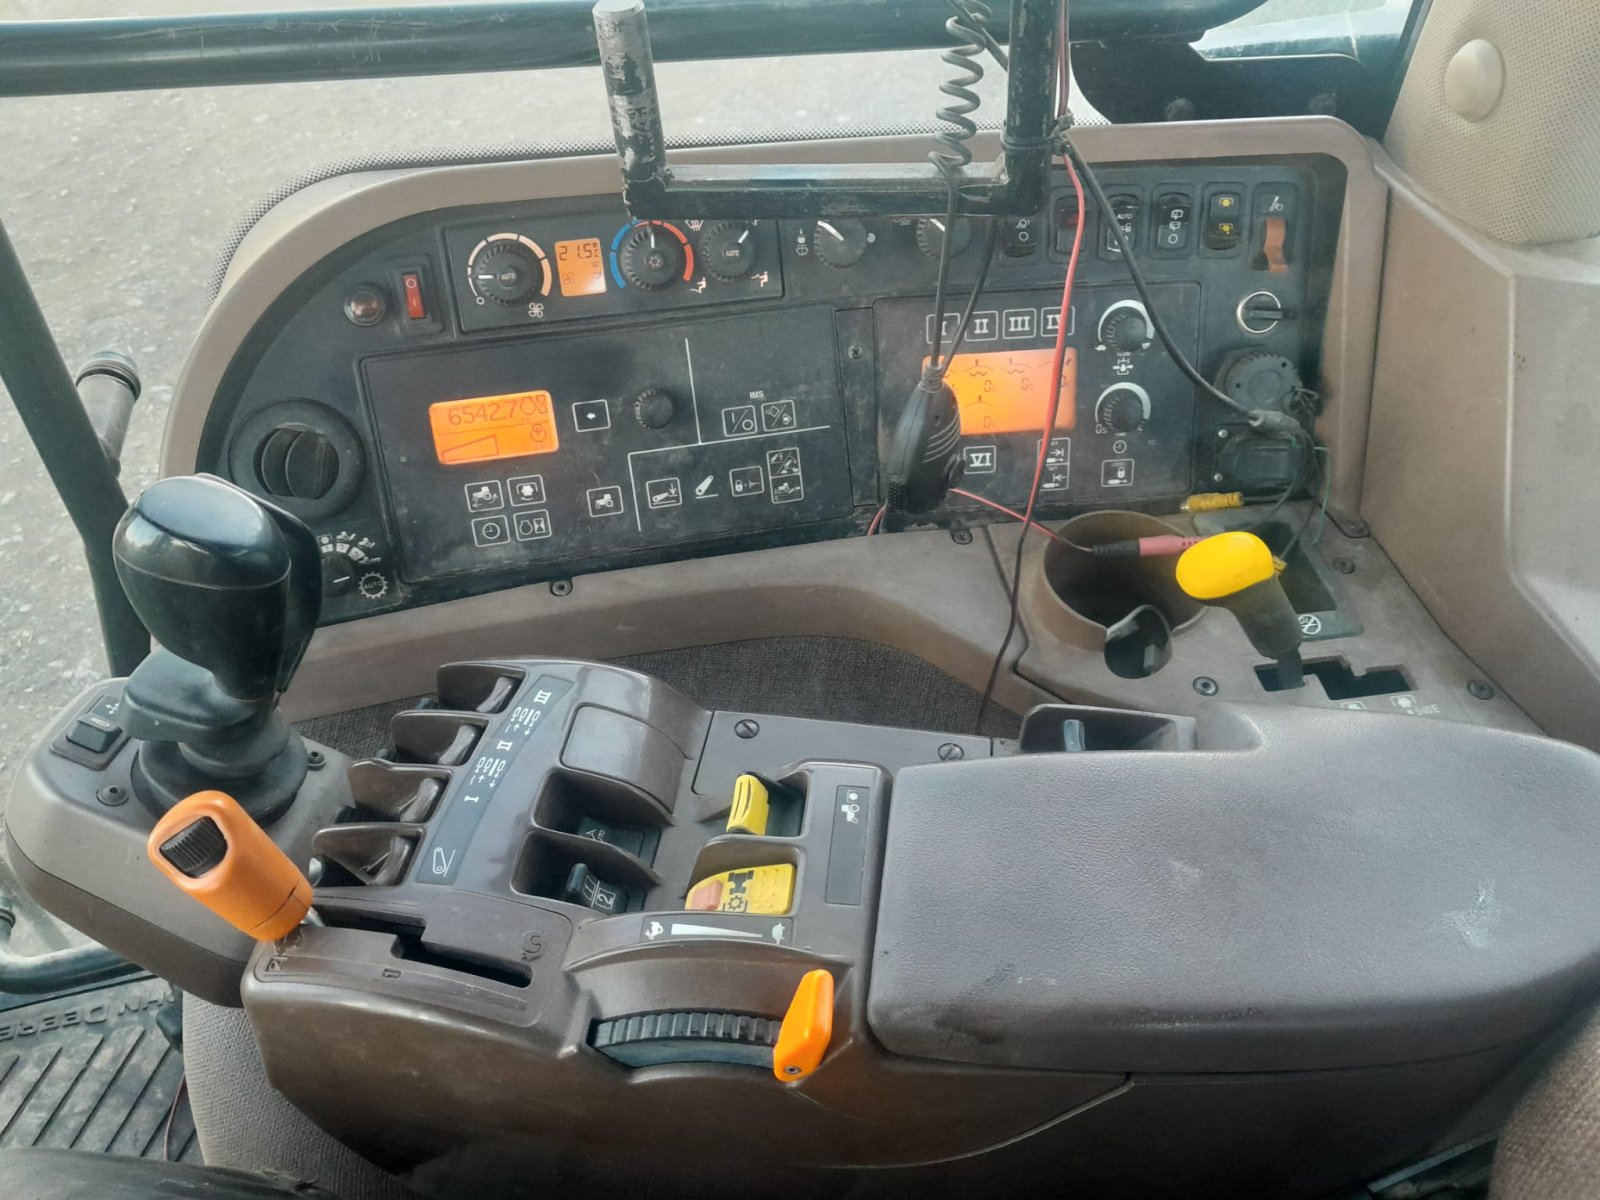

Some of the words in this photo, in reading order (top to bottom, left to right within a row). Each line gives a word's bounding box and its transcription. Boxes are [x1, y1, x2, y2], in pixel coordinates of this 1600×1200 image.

[973, 318, 989, 334] II
[1008, 315, 1031, 332] III
[749, 390, 765, 399] IMS
[447, 399, 518, 426] 6542.7
[969, 452, 993, 468] VI
